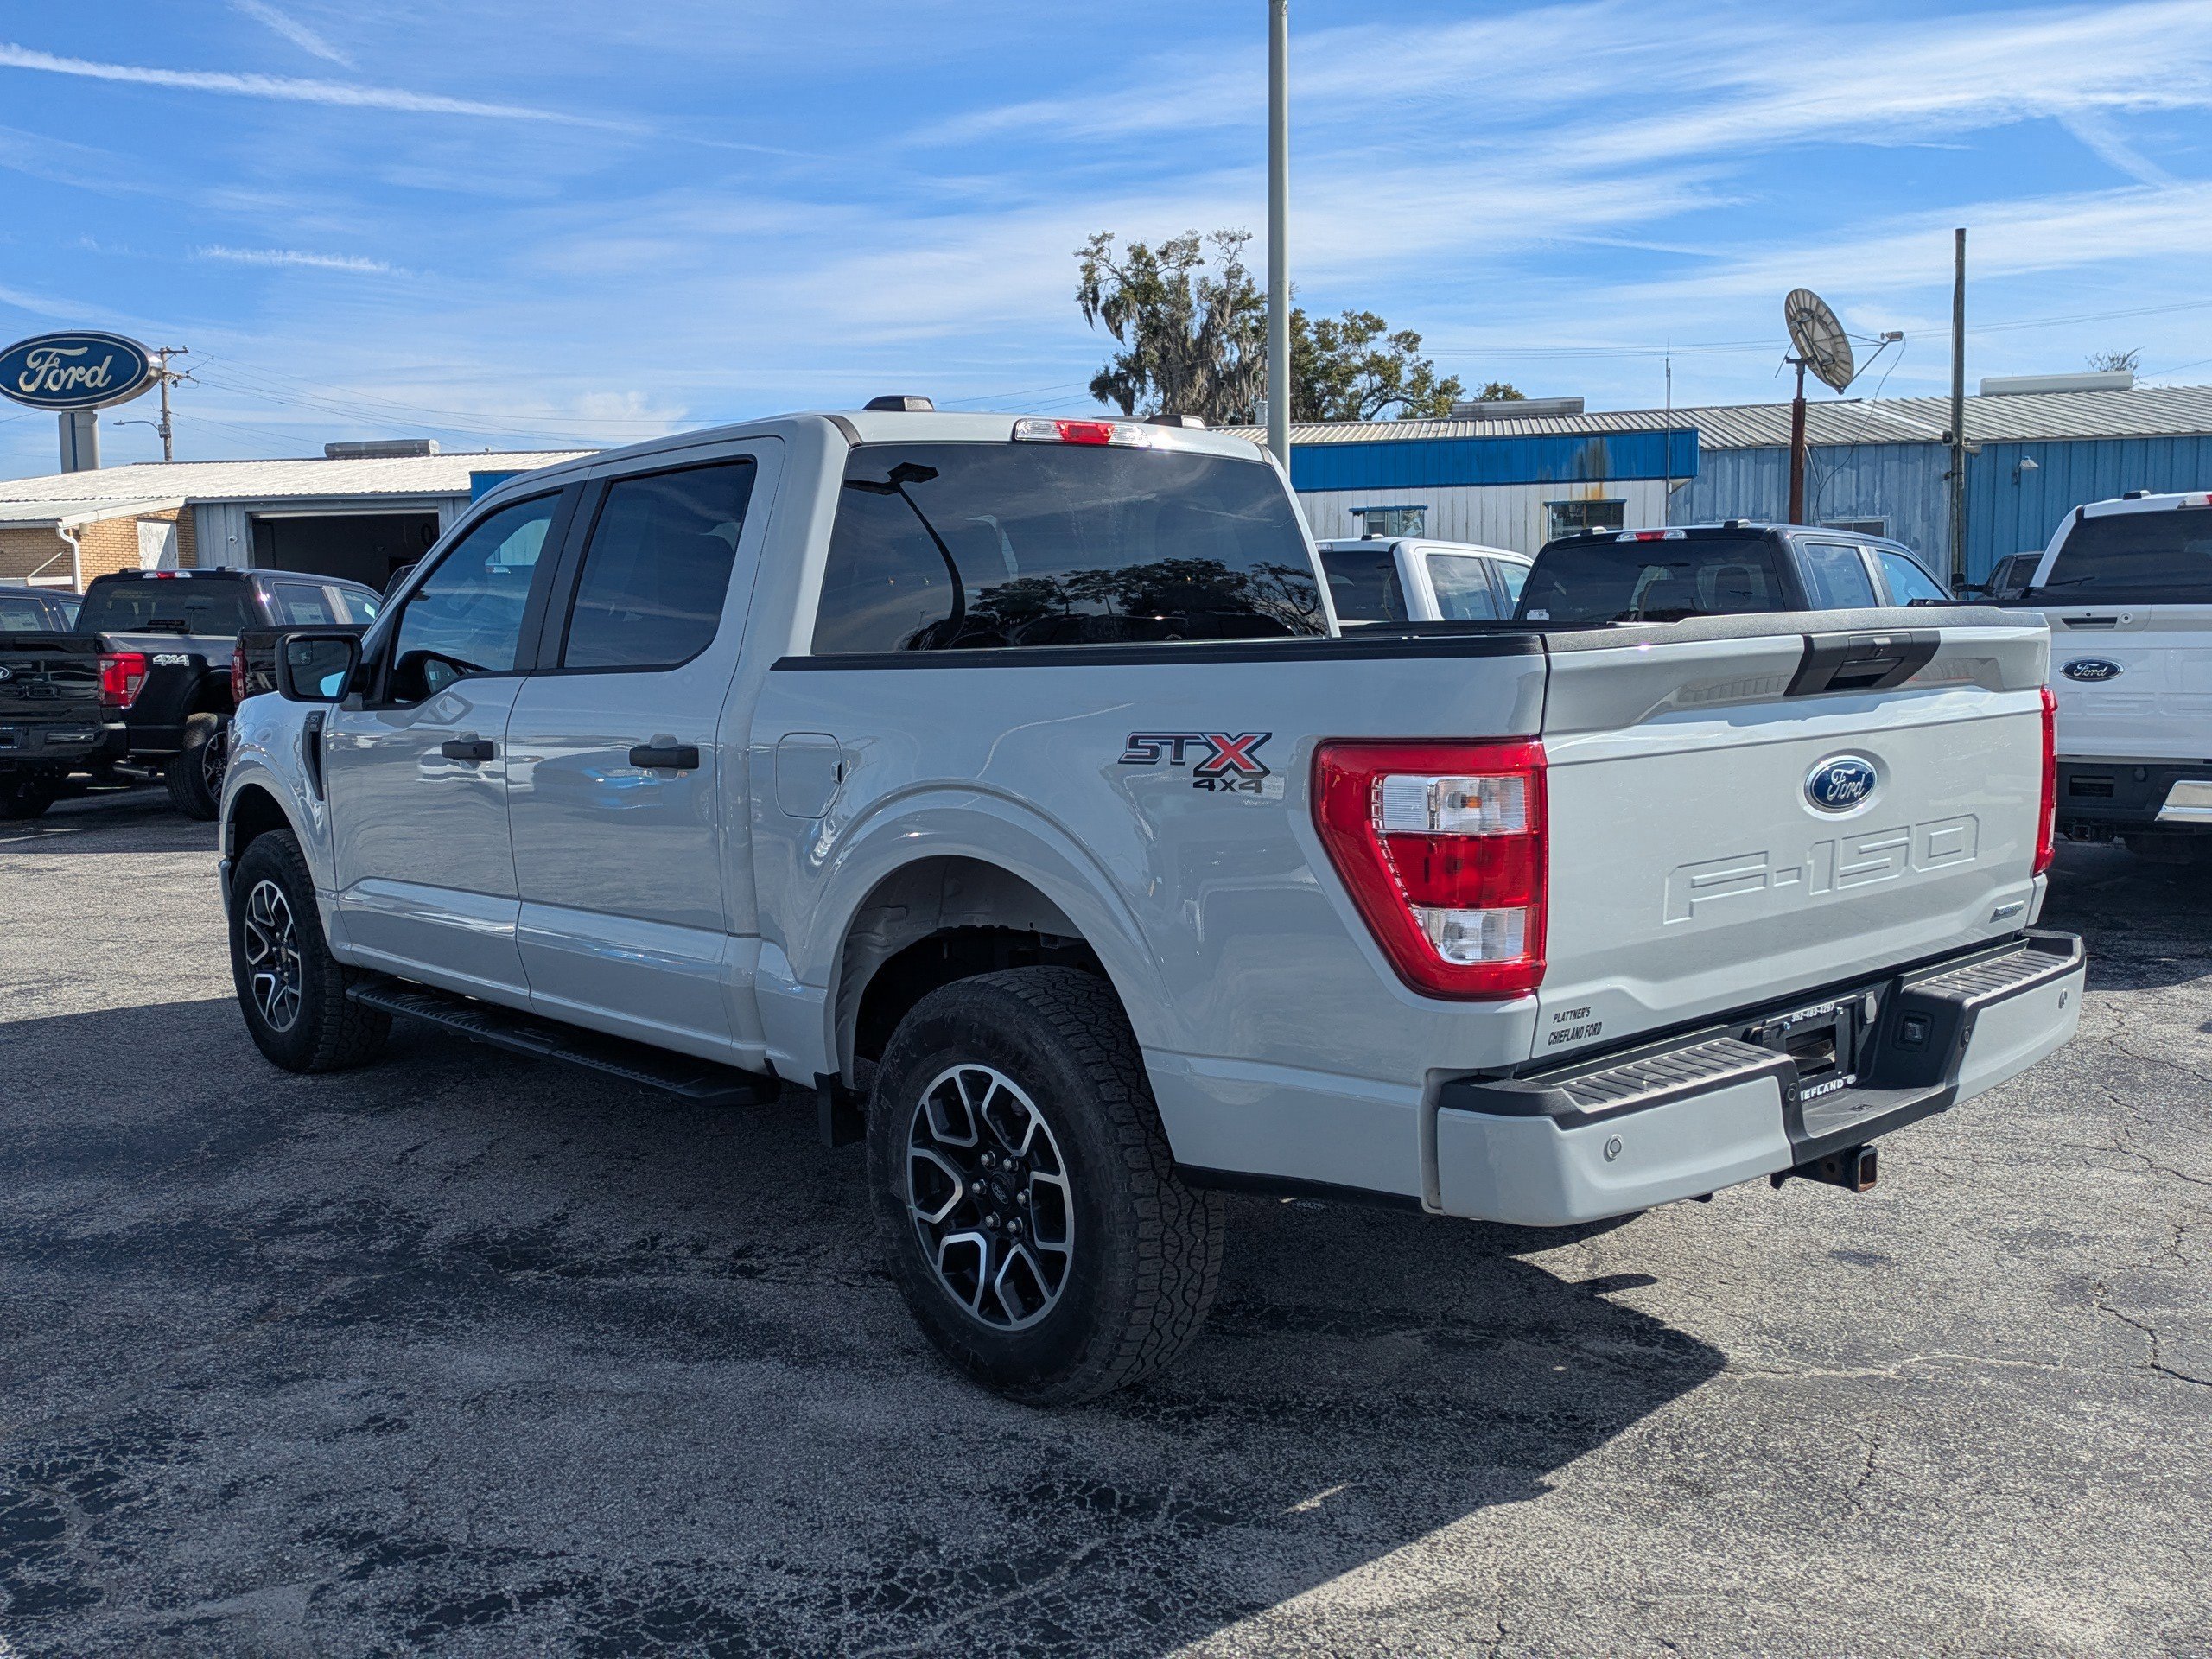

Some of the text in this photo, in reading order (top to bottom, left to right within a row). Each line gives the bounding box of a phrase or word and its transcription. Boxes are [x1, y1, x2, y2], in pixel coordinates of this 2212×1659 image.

[18, 346, 113, 392] Ford
[2074, 663, 2108, 677] Ford
[1117, 732, 1274, 779] STX
[1827, 768, 1866, 802] Ford
[1663, 813, 1980, 925] F-150
[1548, 1021, 1603, 1046] CHIEFLAND FORD
